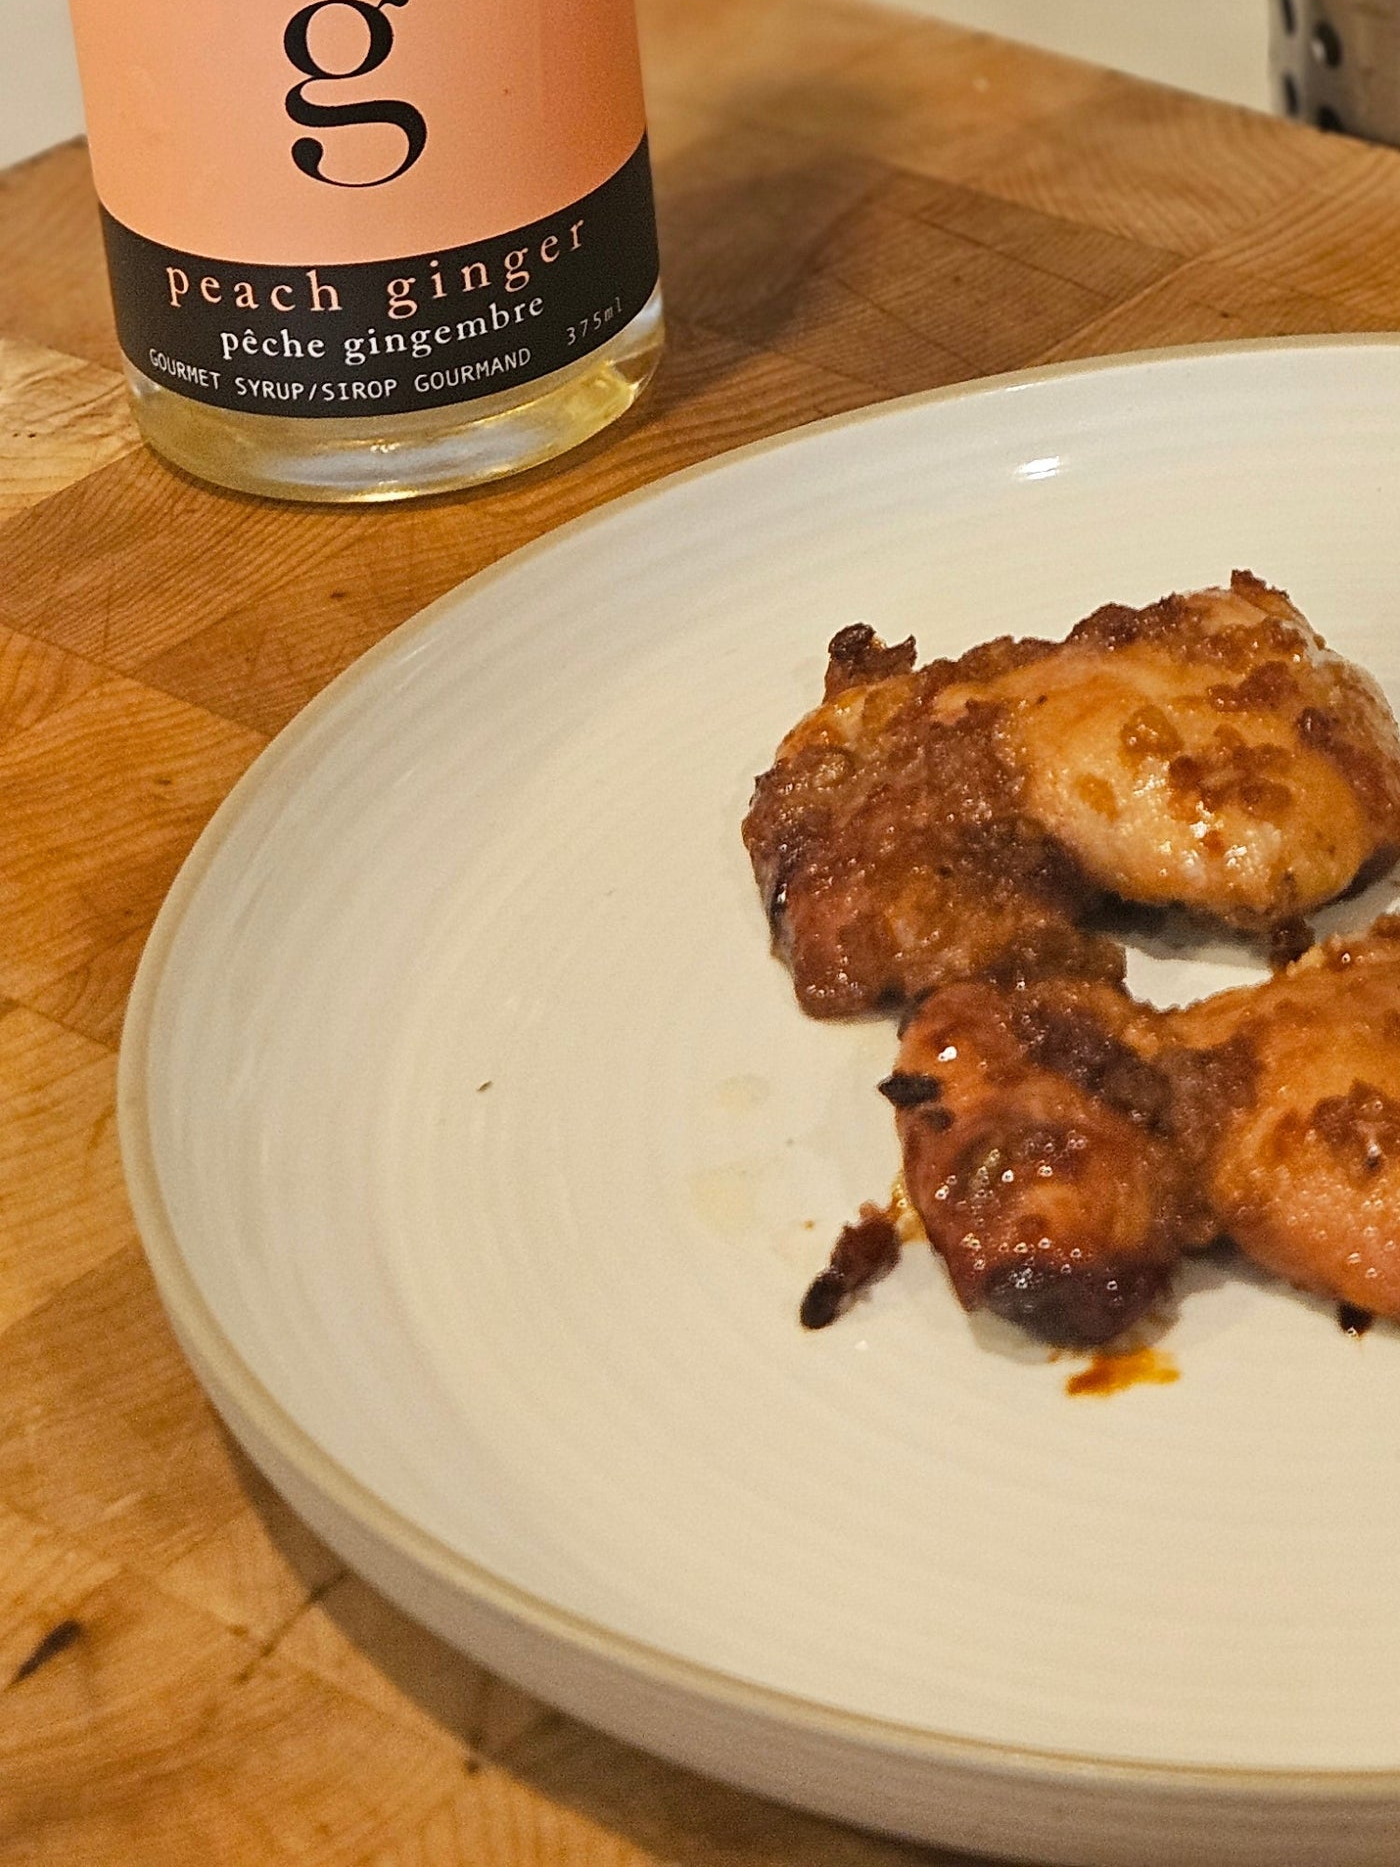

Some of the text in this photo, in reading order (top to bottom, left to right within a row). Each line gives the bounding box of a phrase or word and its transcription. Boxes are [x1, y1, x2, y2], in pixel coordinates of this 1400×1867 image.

[166, 219, 584, 320] peach ginger
[220, 296, 544, 366] pêche gingembre
[565, 296, 623, 346] 375ml
[149, 347, 532, 402] GOURMET SYRUP/SIROP GOURMAND
